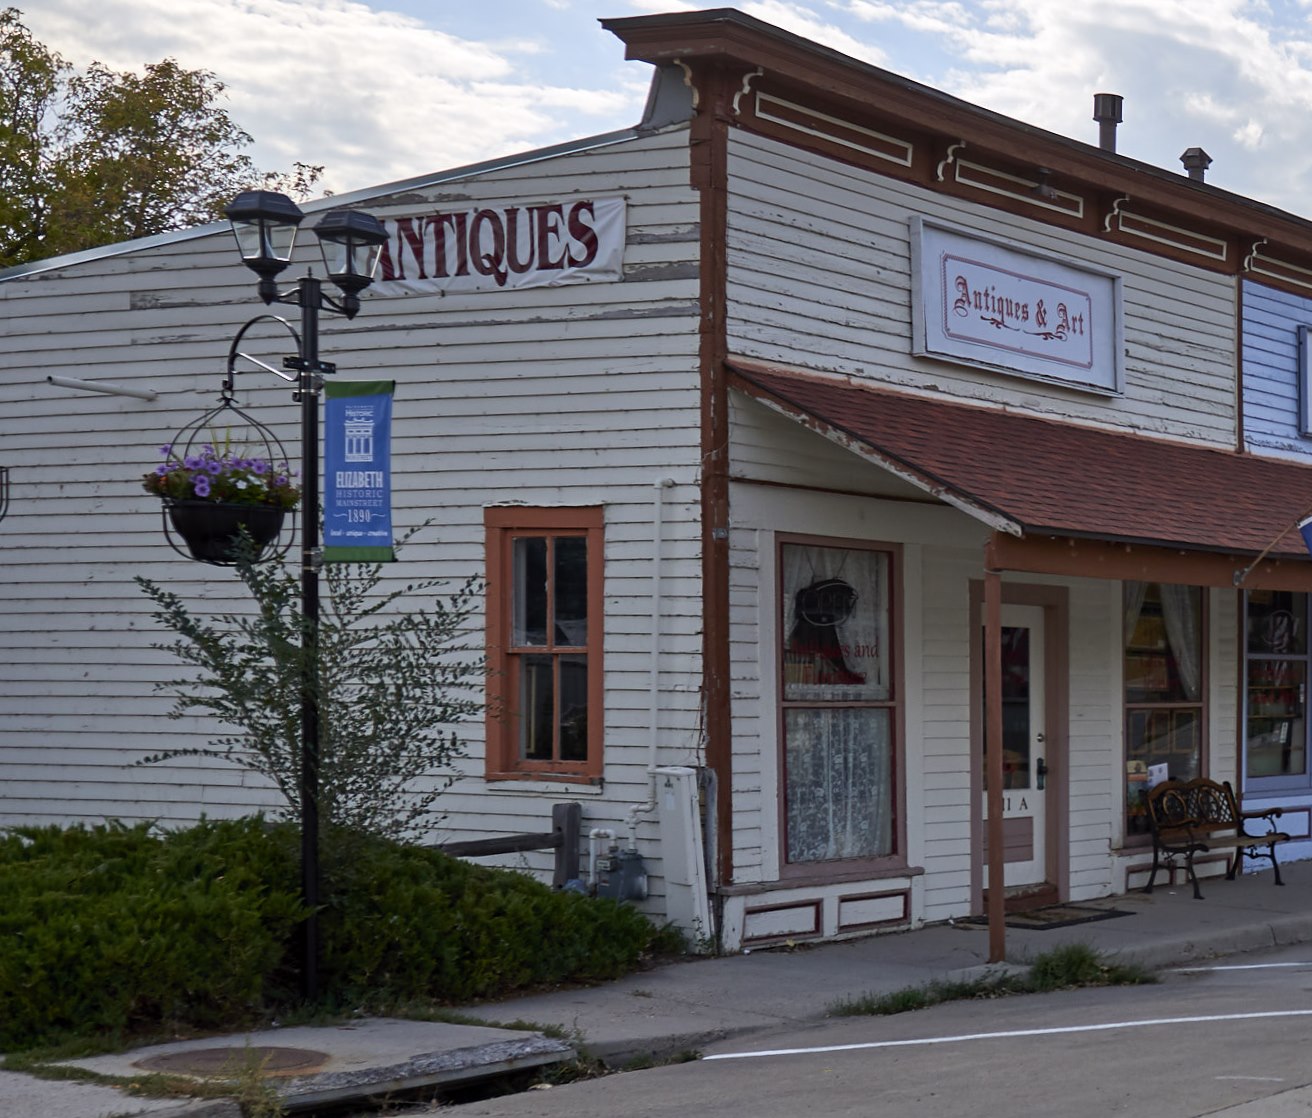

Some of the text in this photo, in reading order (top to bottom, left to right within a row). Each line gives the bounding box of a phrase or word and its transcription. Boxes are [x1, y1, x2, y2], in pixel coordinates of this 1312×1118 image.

[367, 201, 599, 287] ANTIQUES
[952, 275, 1085, 341] Antiques & Art
[336, 471, 384, 489] ELIZABETH
[336, 490, 383, 498] HISTORIC
[347, 509, 371, 523] 1890
[854, 636, 880, 658] and
[1018, 796, 1029, 812] A
